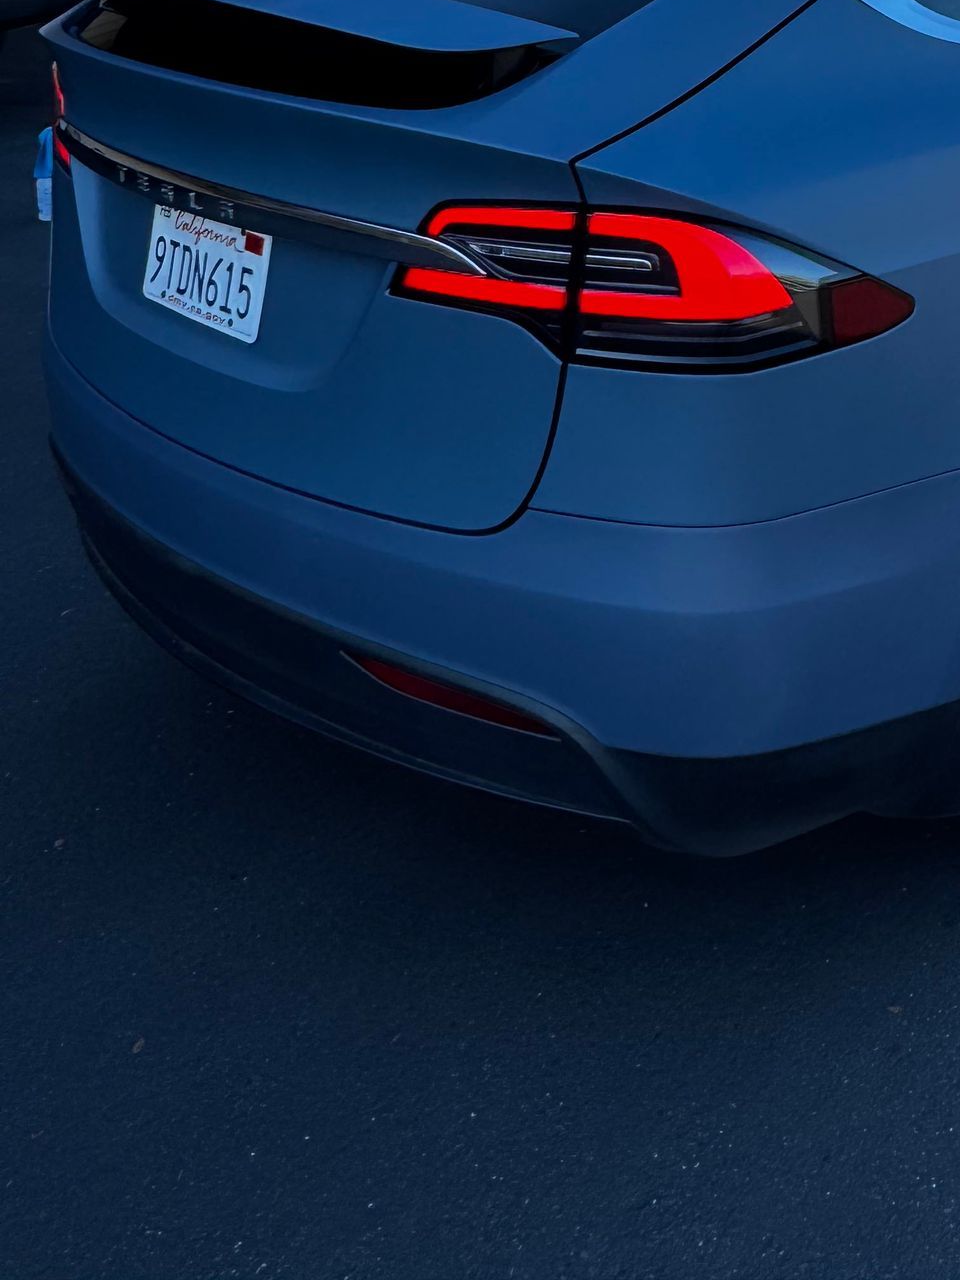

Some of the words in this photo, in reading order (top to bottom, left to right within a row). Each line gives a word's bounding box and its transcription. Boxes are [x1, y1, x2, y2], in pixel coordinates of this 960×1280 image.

[117, 166, 235, 219] TESLA
[174, 208, 245, 253] California
[149, 235, 254, 320] 9TDN615
